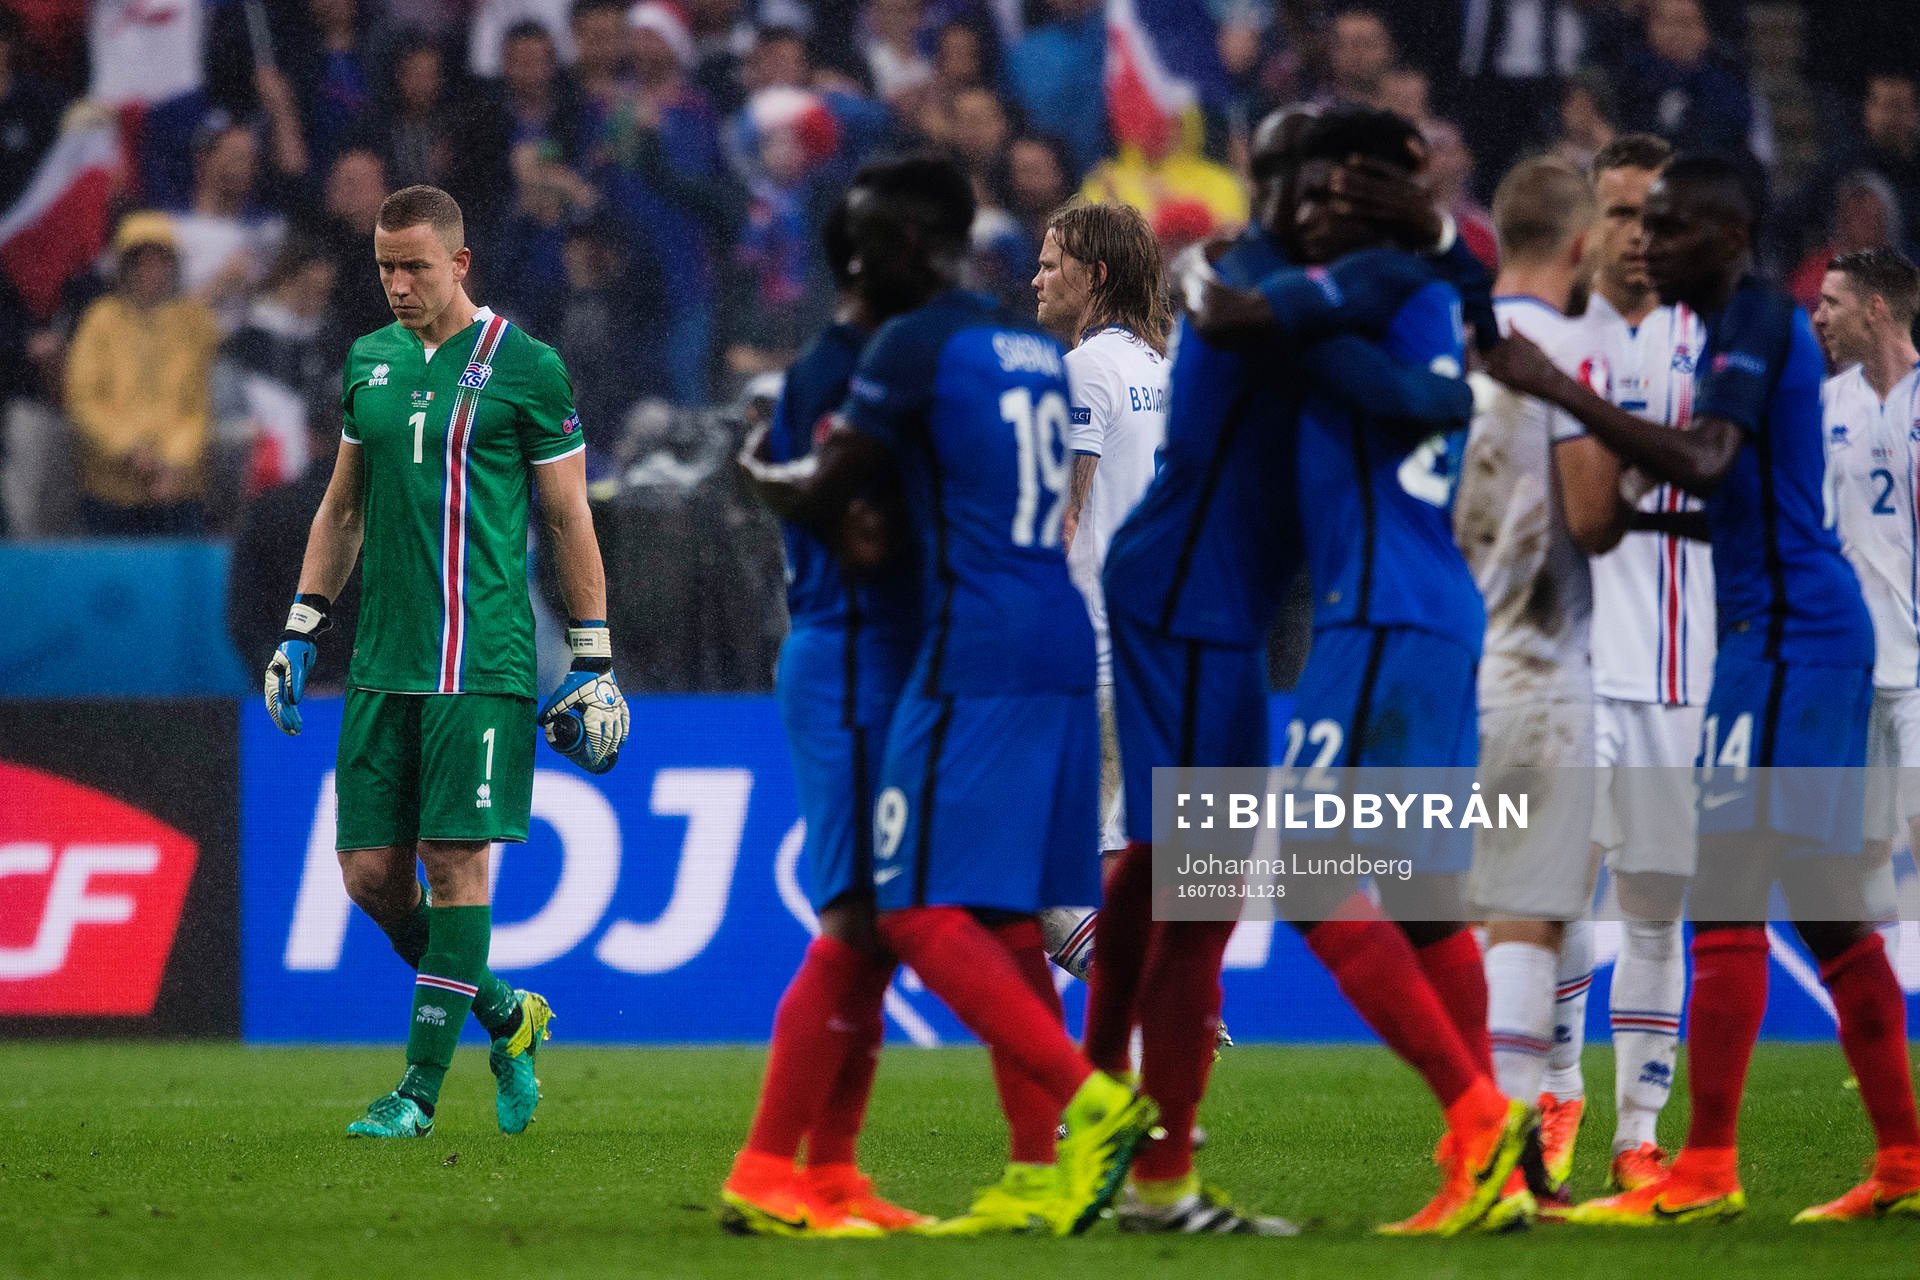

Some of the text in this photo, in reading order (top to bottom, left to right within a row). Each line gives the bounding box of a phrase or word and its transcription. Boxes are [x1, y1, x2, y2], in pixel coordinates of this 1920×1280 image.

[408, 411, 427, 464] 1
[999, 386, 1072, 548] 19
[1869, 466, 1897, 516] 2
[482, 728, 496, 780] 1
[1703, 712, 1754, 783] 14
